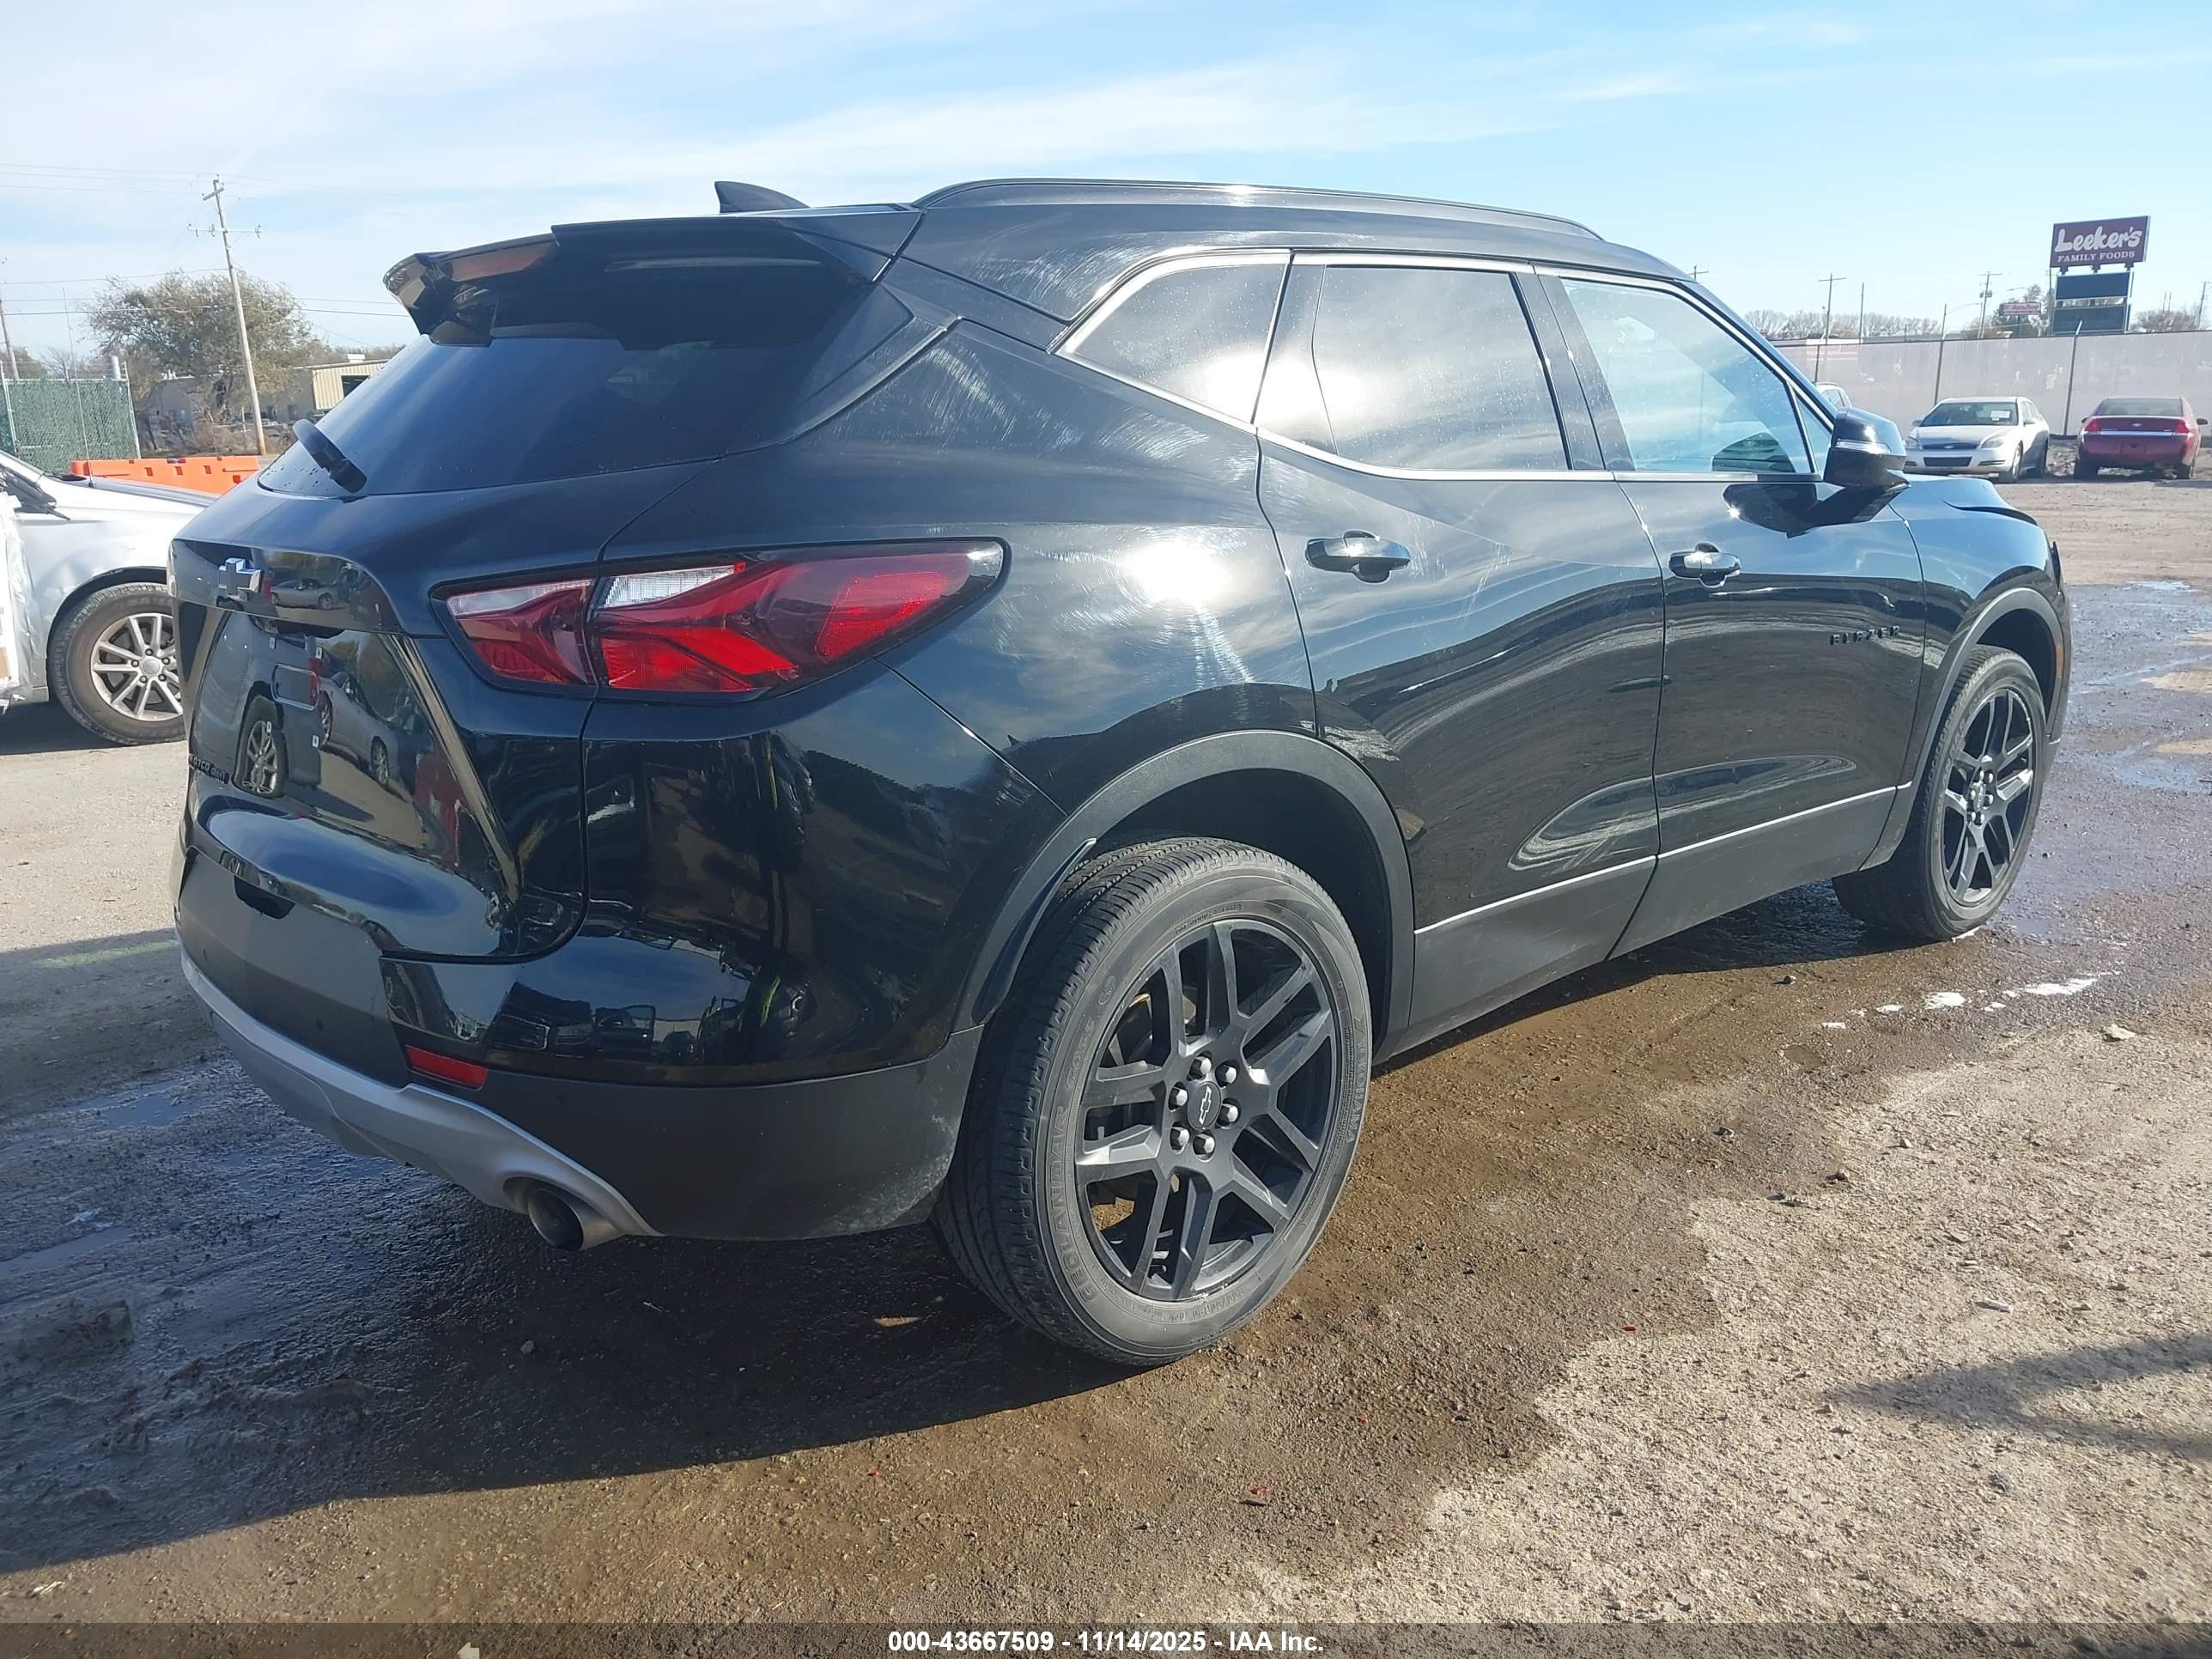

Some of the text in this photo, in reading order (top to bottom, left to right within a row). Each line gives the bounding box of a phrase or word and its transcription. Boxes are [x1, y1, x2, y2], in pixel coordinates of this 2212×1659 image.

[2054, 226, 2142, 252] Leeker's
[2057, 251, 2136, 263] FAMILY FOODS
[1048, 1105, 1098, 1303] GEOLANDAR
